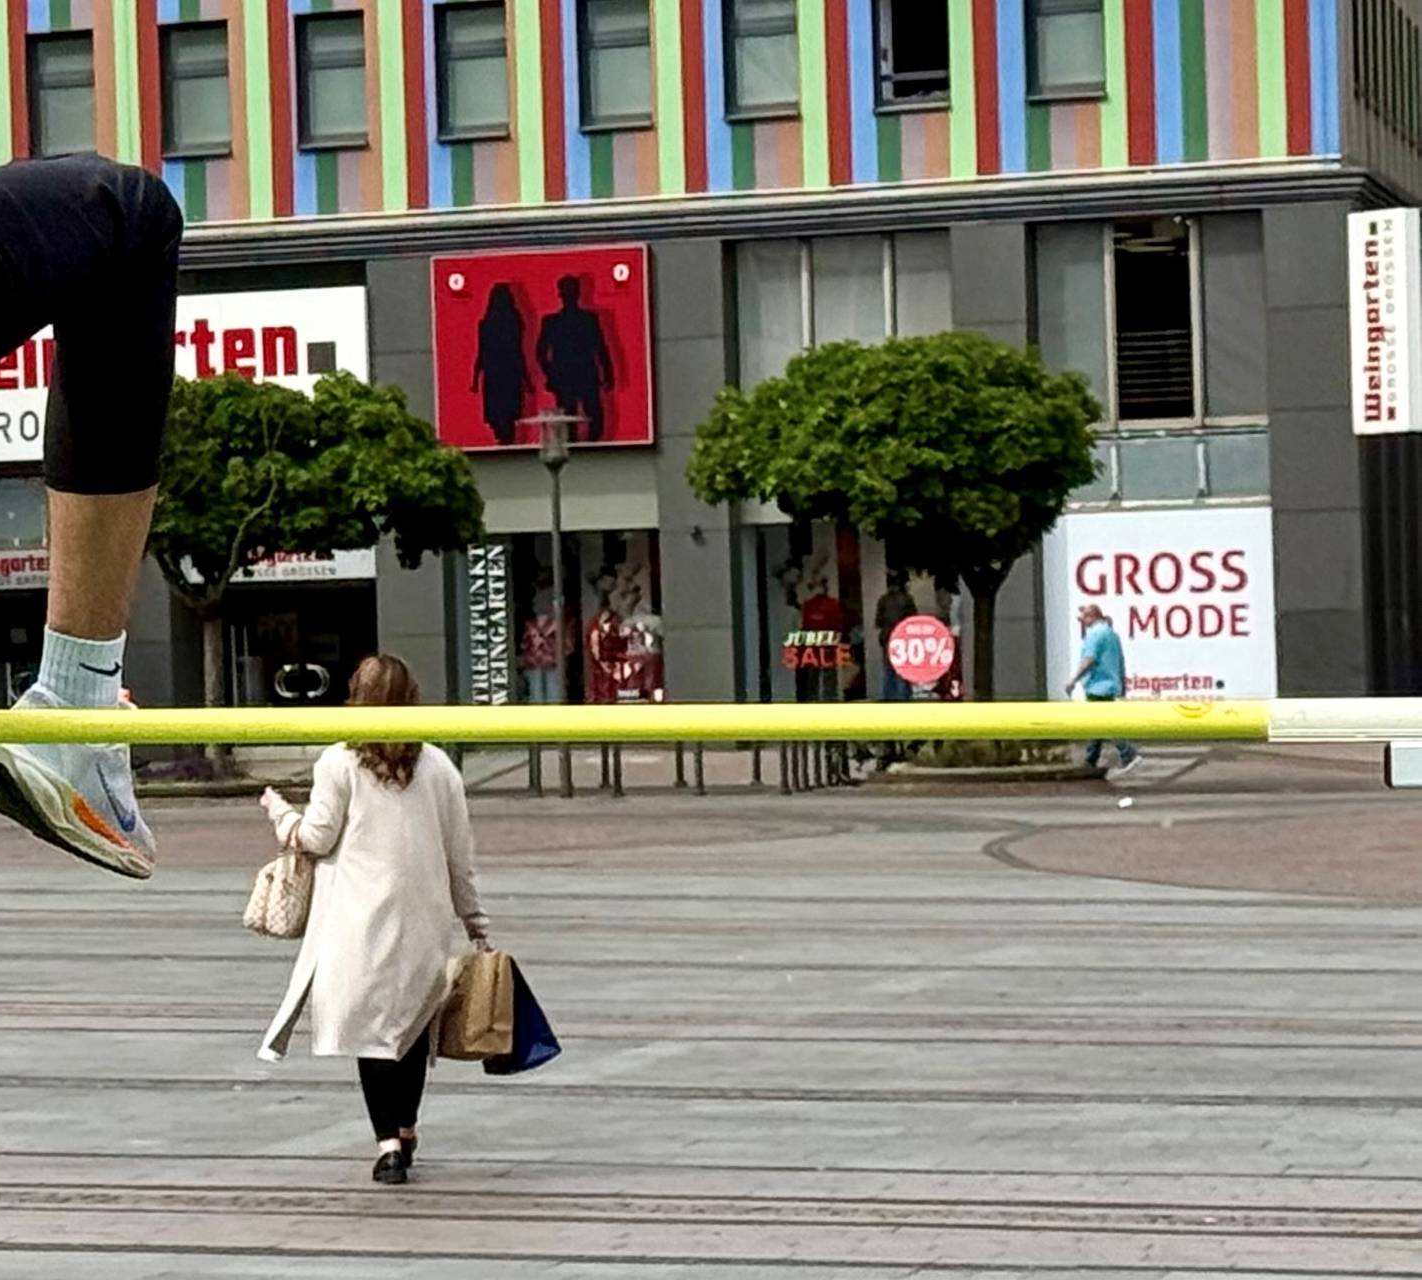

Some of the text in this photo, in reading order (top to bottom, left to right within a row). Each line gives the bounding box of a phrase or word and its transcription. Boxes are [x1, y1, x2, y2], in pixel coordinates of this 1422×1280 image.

[1363, 241, 1385, 423] Weingarten
[1076, 550, 1249, 596] GROSS
[467, 542, 489, 704] TREFFPUNKT
[487, 544, 509, 705] WEINGARTEN
[1129, 603, 1251, 639] MODE
[781, 645, 852, 669] SALE
[889, 637, 954, 667] 30%
[1124, 673, 1214, 698] eingarten
